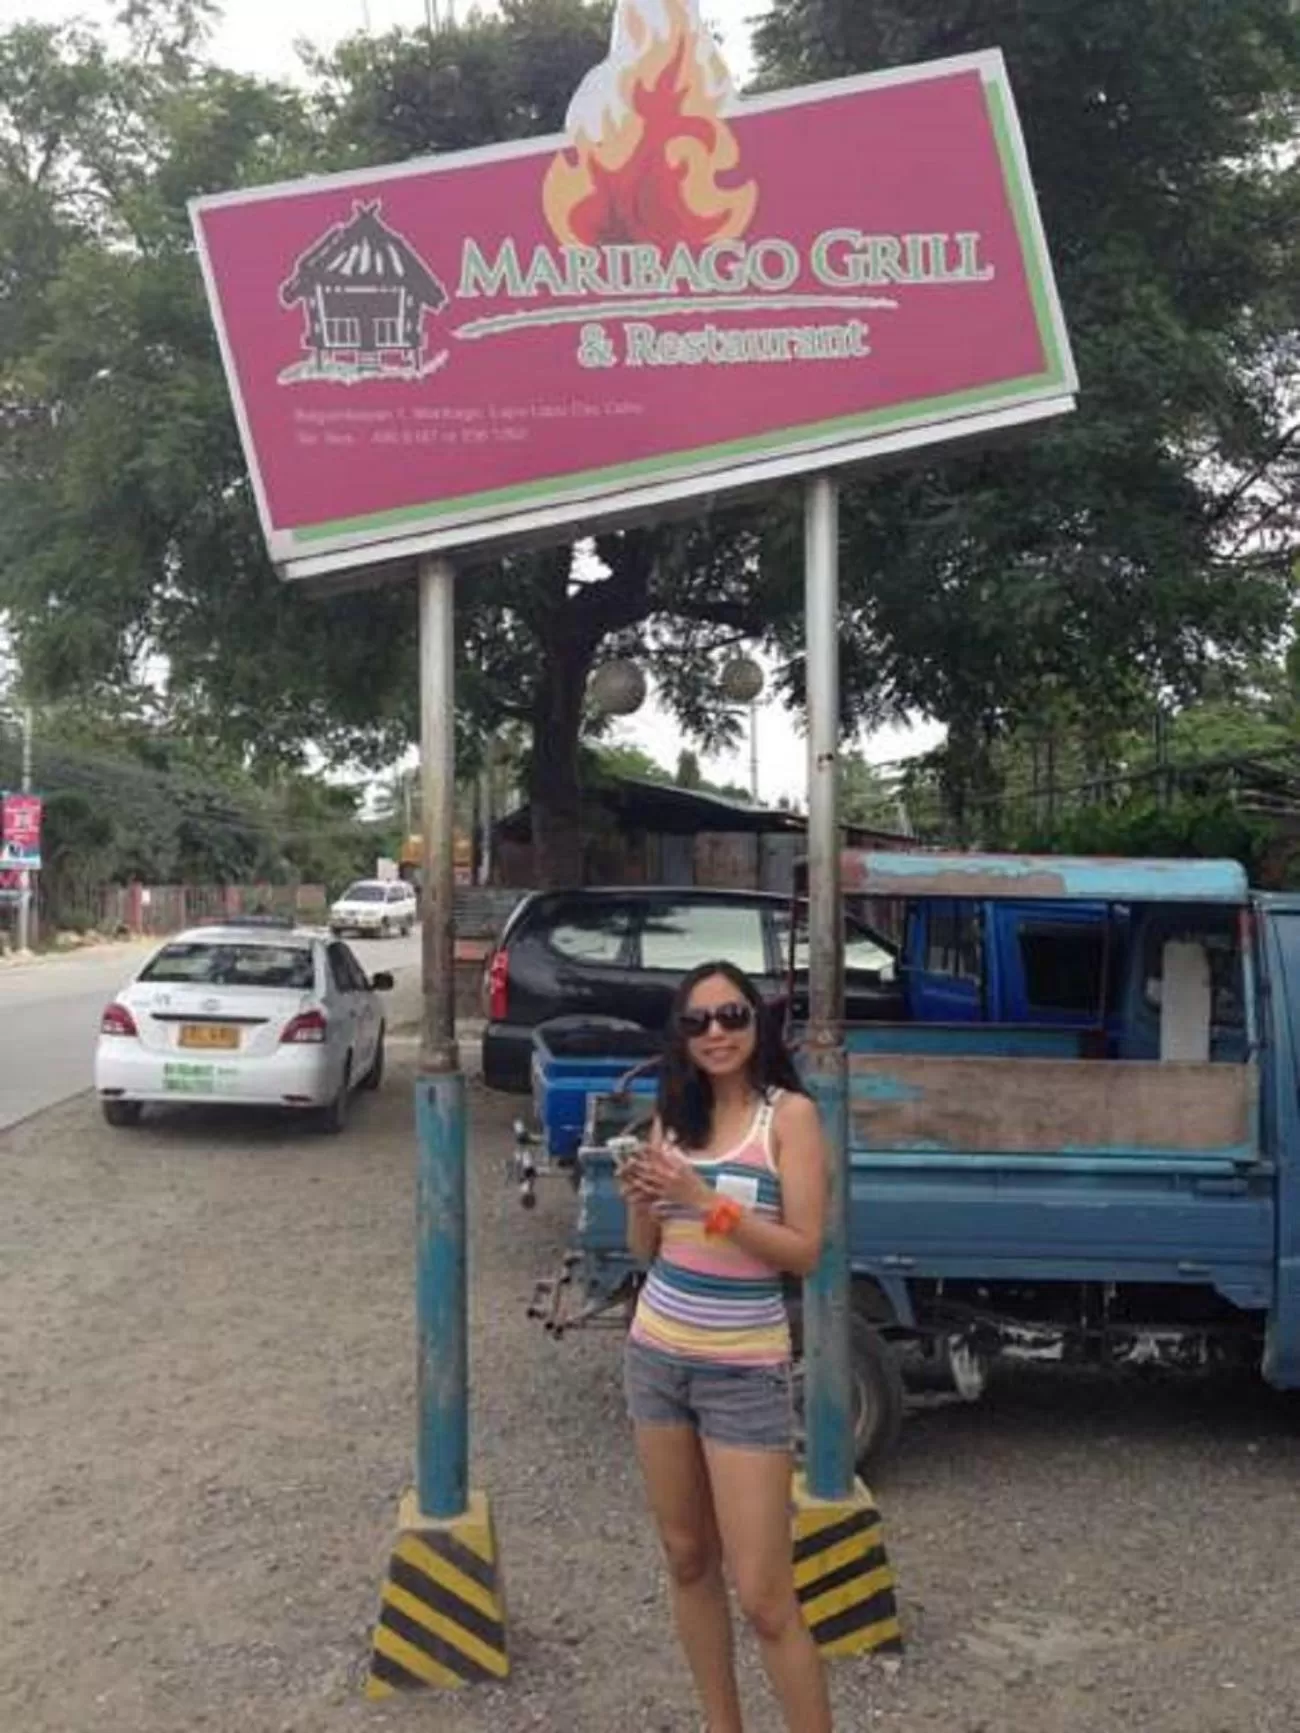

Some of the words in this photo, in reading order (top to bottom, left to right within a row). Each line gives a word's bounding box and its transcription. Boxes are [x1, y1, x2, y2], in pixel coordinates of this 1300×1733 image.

[456, 237, 799, 297] MARIBAGO
[811, 228, 995, 287] GRILL
[577, 323, 617, 368] &
[624, 318, 871, 366] Restaurant
